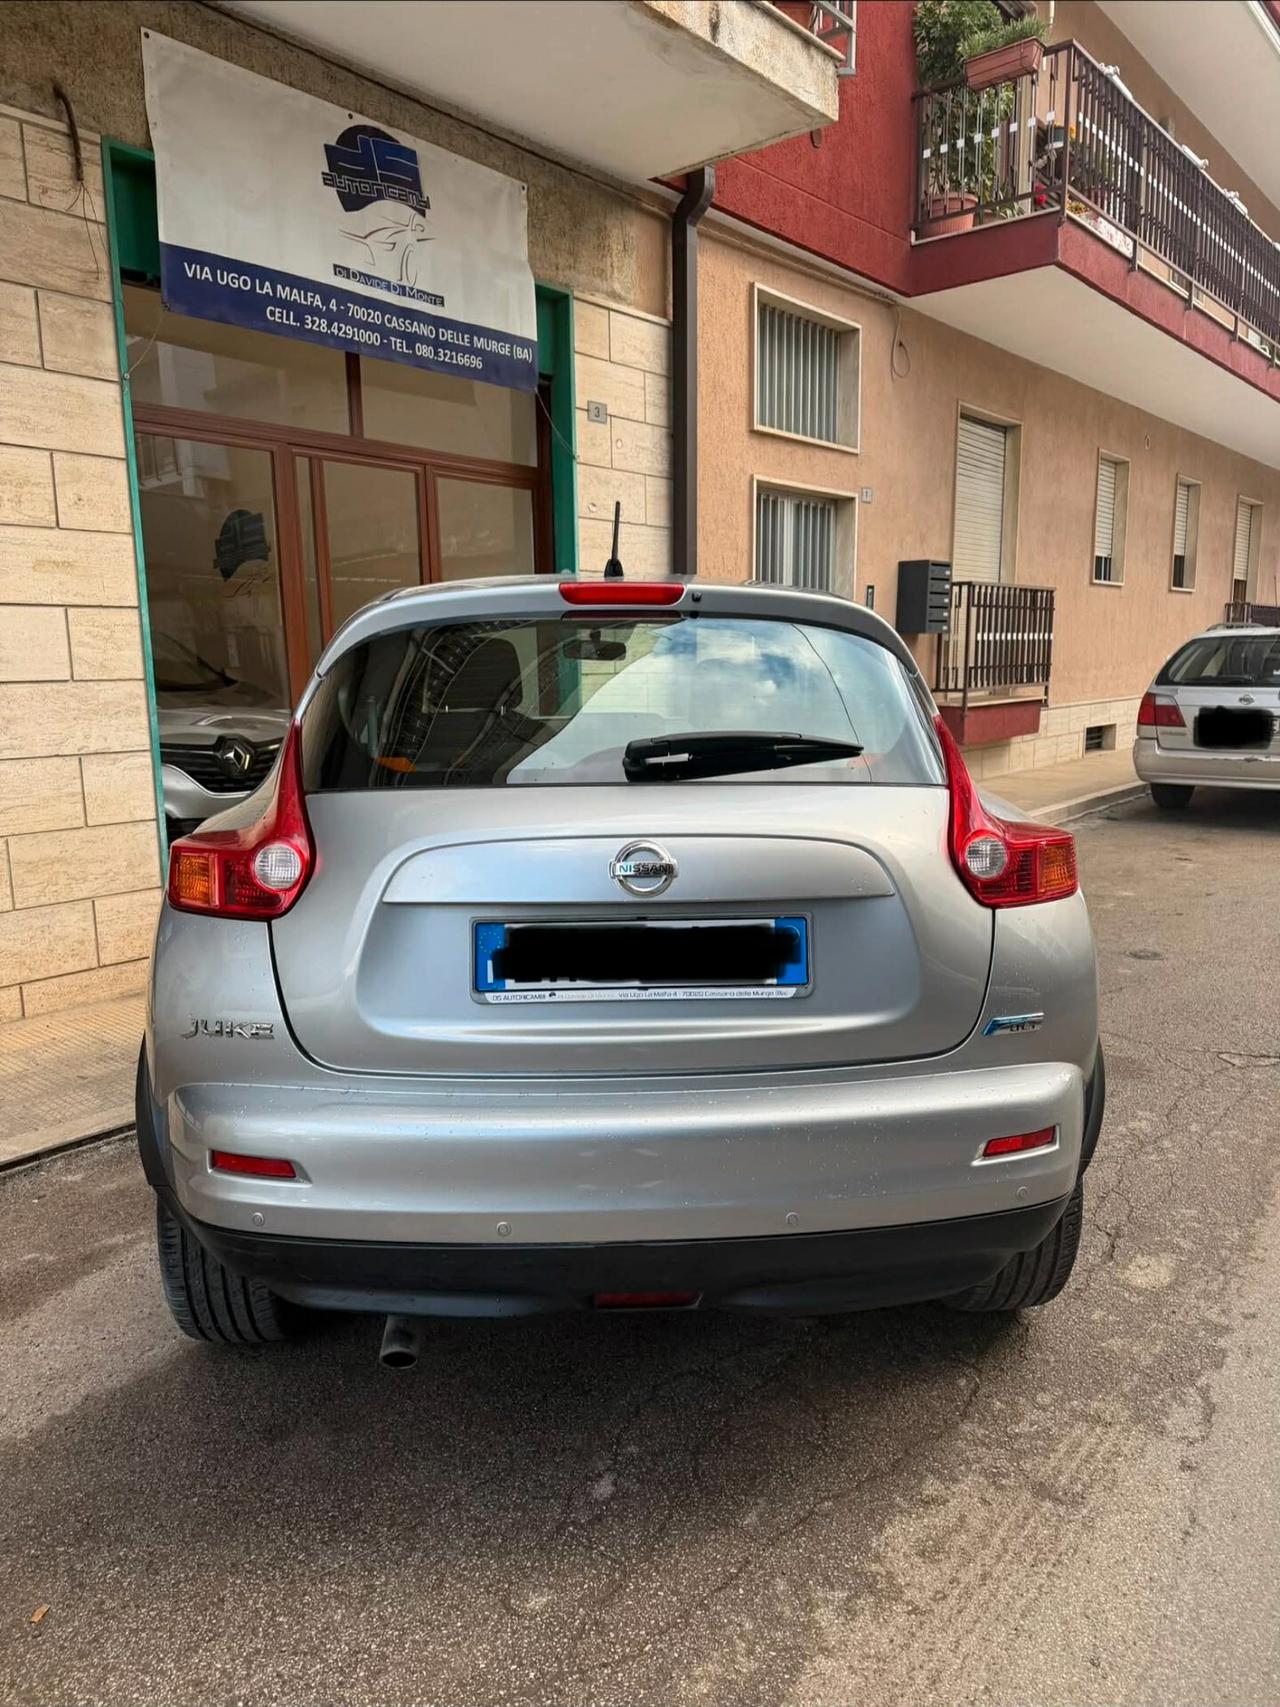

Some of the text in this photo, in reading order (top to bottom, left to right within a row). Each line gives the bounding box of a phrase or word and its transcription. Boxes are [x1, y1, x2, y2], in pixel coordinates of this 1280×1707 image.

[183, 262, 213, 282] VIA
[216, 269, 251, 291] UGO
[255, 279, 273, 297] LA
[276, 284, 327, 312] MALFA,
[329, 299, 337, 313] 4
[347, 303, 382, 325] 70020
[384, 314, 436, 339] CASSANO
[438, 328, 471, 347] DELLE
[473, 335, 511, 356] MURGE
[513, 344, 533, 364] (BA)
[266, 306, 301, 327] CELL.
[304, 315, 381, 346] 328.4291000
[389, 336, 413, 354] TEL.
[415, 342, 483, 370] 080.3216696
[594, 406, 600, 418] 3
[618, 864, 668, 874] NISSAN
[181, 1018, 275, 1040] JUKE
